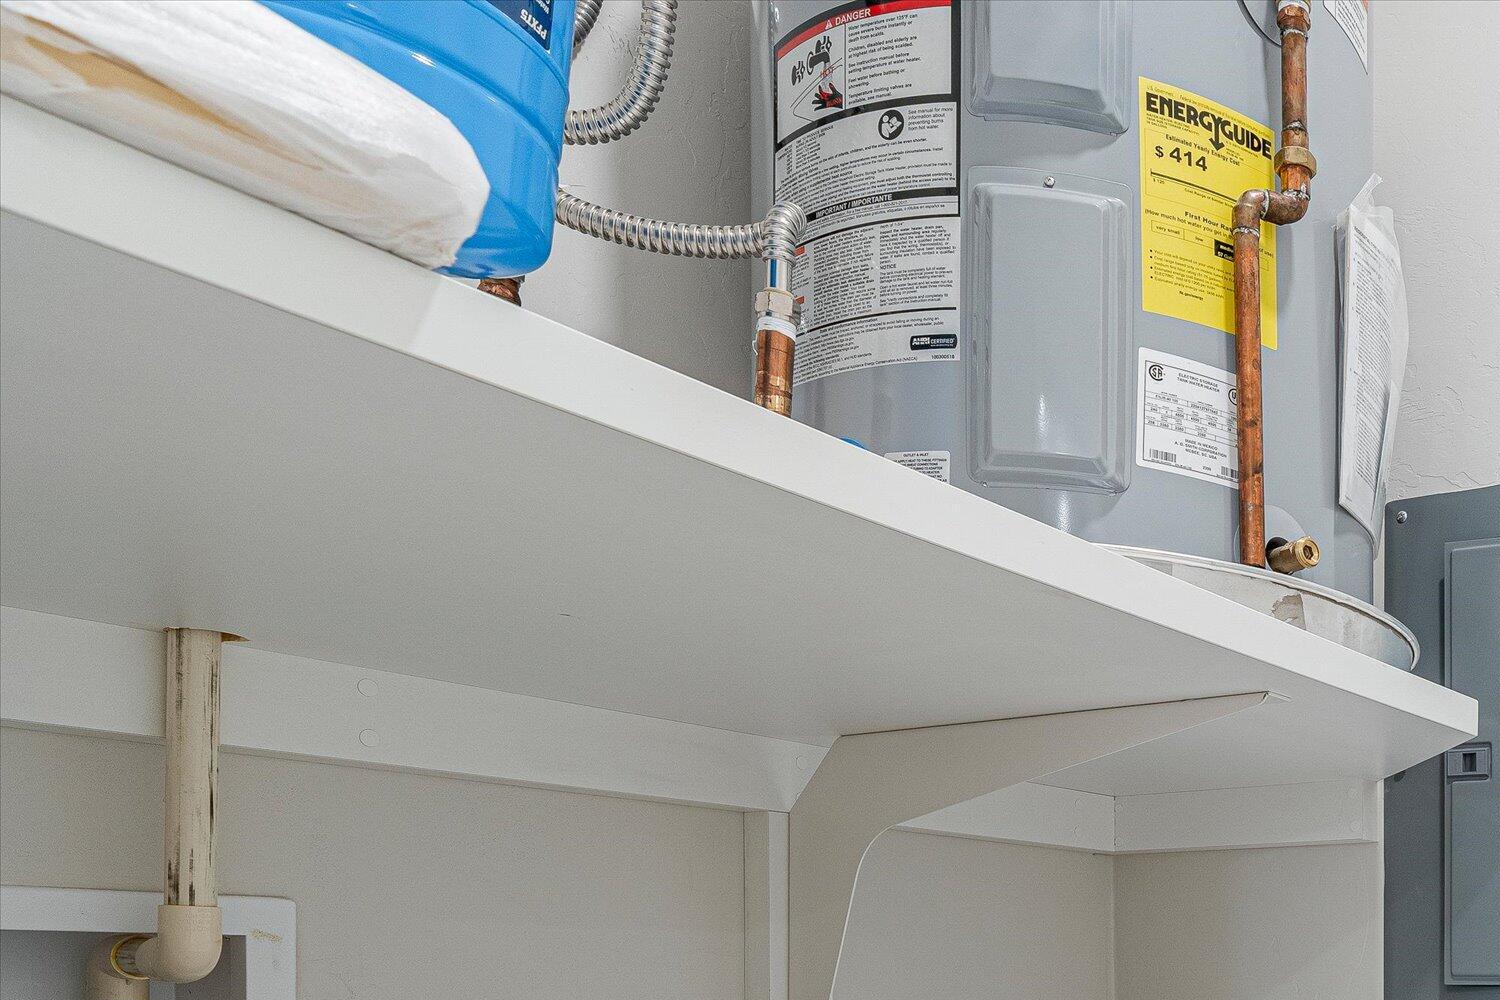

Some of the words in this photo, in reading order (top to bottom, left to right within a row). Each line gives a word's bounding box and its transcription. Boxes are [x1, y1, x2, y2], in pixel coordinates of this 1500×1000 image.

[836, 8, 871, 25] DANGER
[1166, 134, 1192, 147] Estimated
[1194, 142, 1210, 154] Yearly
[1212, 150, 1228, 162] Energy
[1155, 146, 1164, 158] $
[1170, 147, 1207, 172] 414
[815, 202, 848, 219] IMPORTANT
[852, 194, 892, 208] IMPORTANTE
[1161, 212, 1176, 220] much
[1188, 220, 1202, 228] water
[1185, 211, 1200, 222] First
[1202, 217, 1218, 227] Hour
[1168, 227, 1180, 235] small
